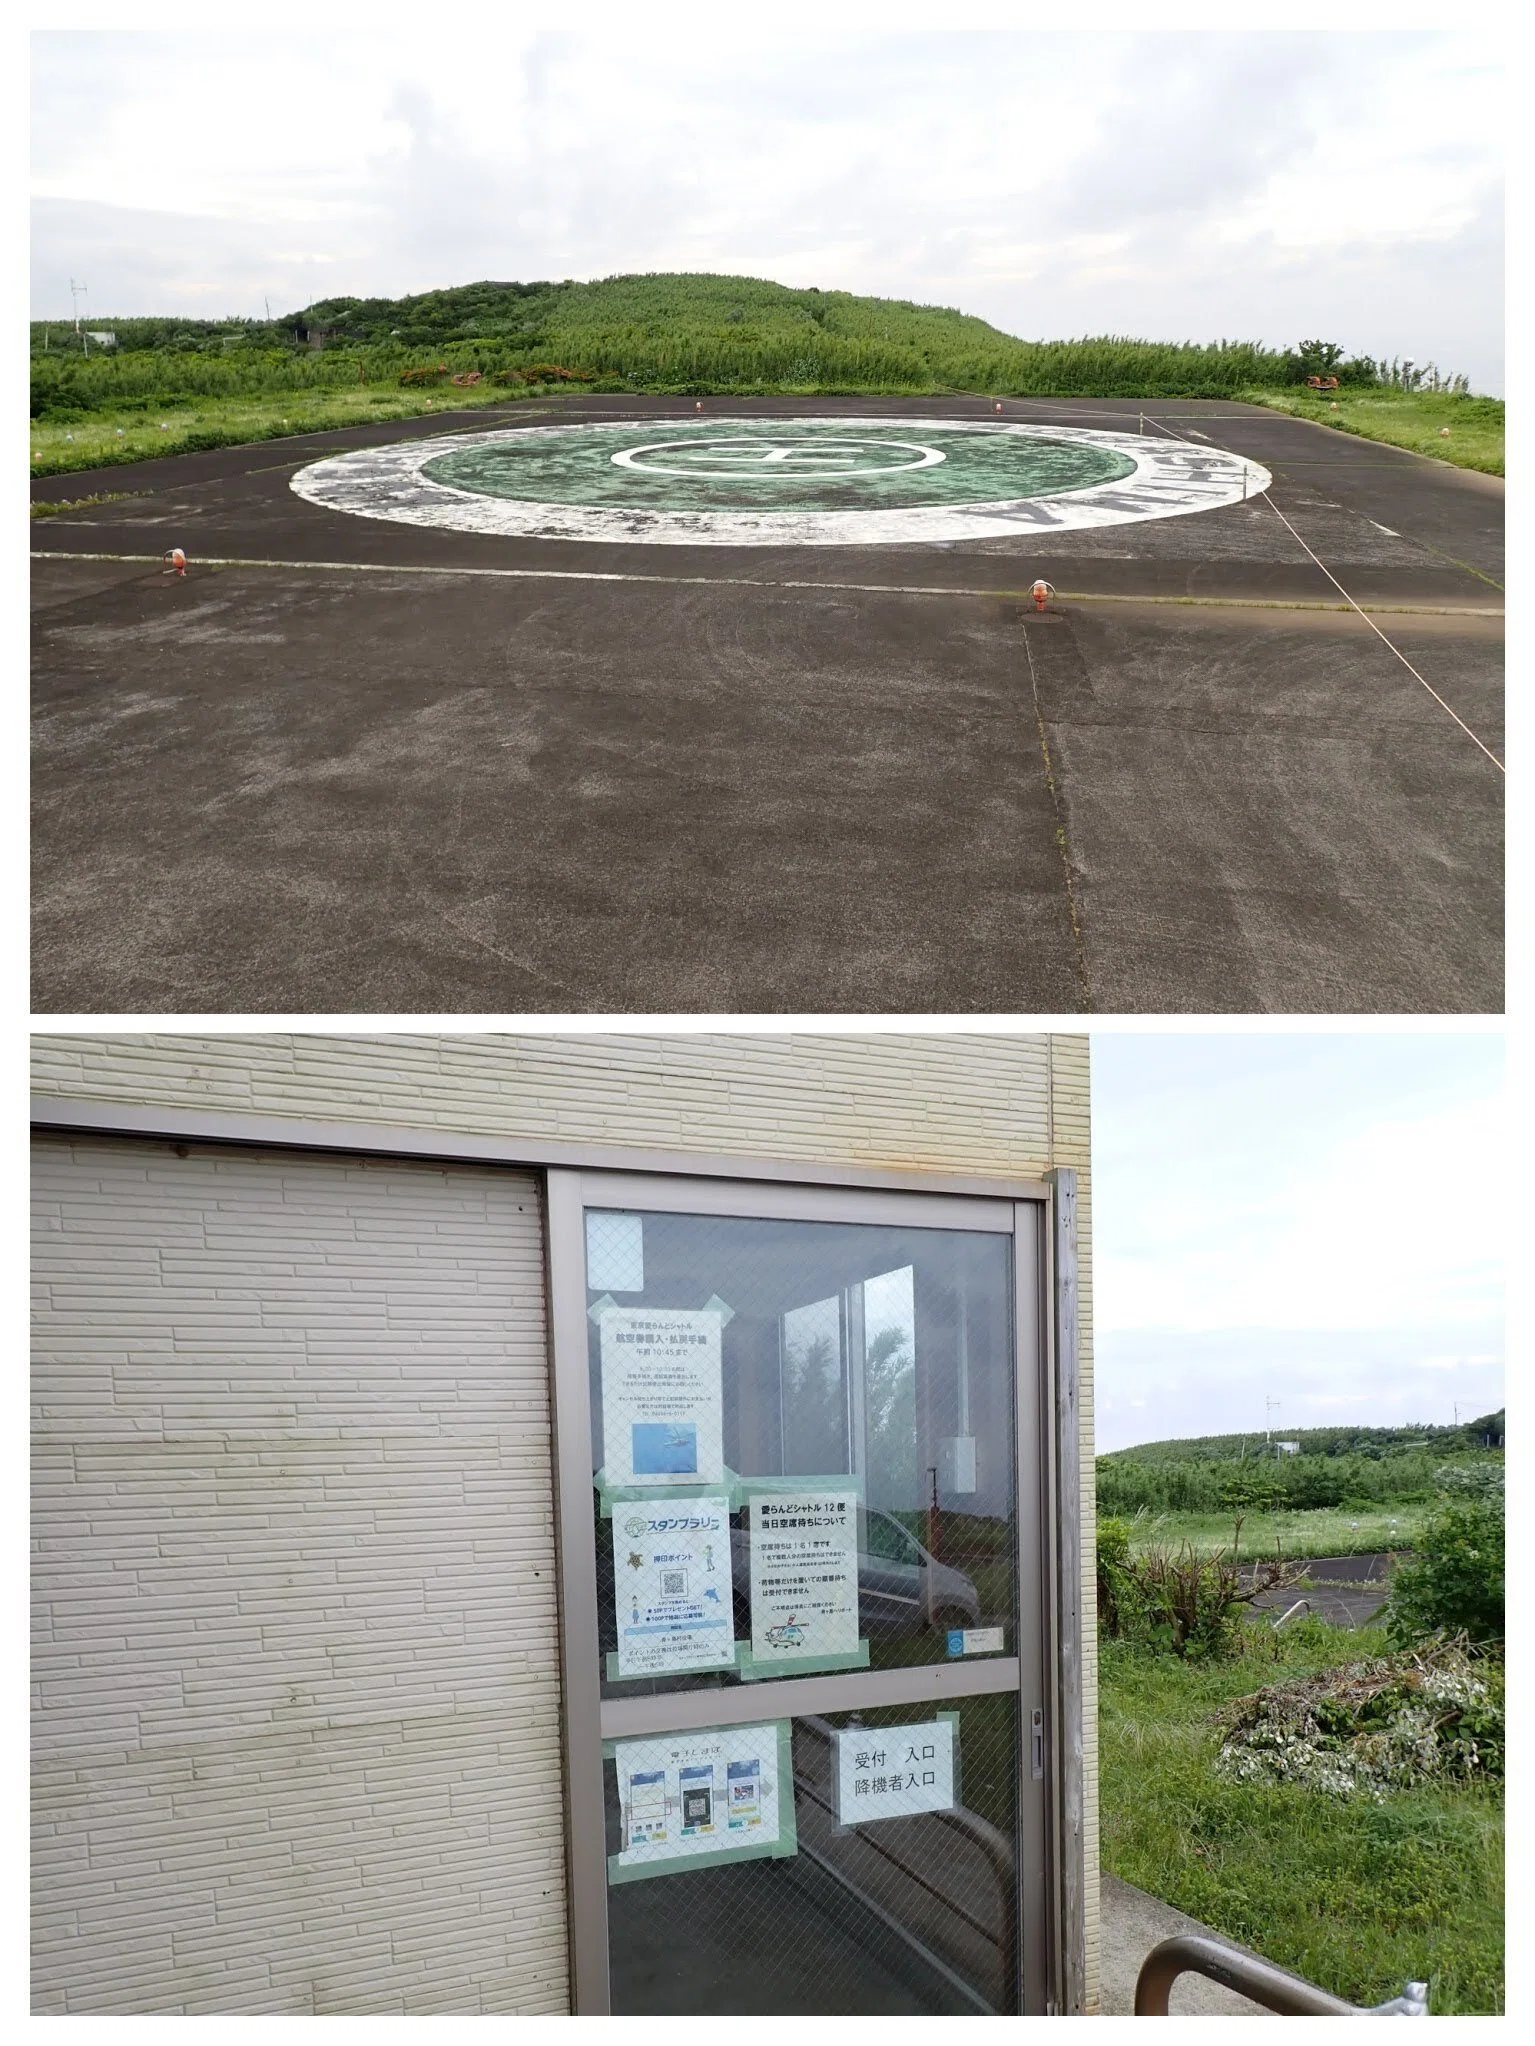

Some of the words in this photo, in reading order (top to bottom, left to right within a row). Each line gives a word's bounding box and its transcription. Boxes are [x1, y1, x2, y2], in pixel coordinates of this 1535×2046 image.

[761, 1504, 821, 1515] 愛らんどシャトル
[825, 1503, 835, 1512] 12
[837, 1503, 846, 1512] 便
[762, 1517, 847, 1529] 当日空席待ちについて
[855, 1750, 887, 1770] 受付
[905, 1745, 935, 1763] 入口
[855, 1771, 935, 1797] 降機者入口
